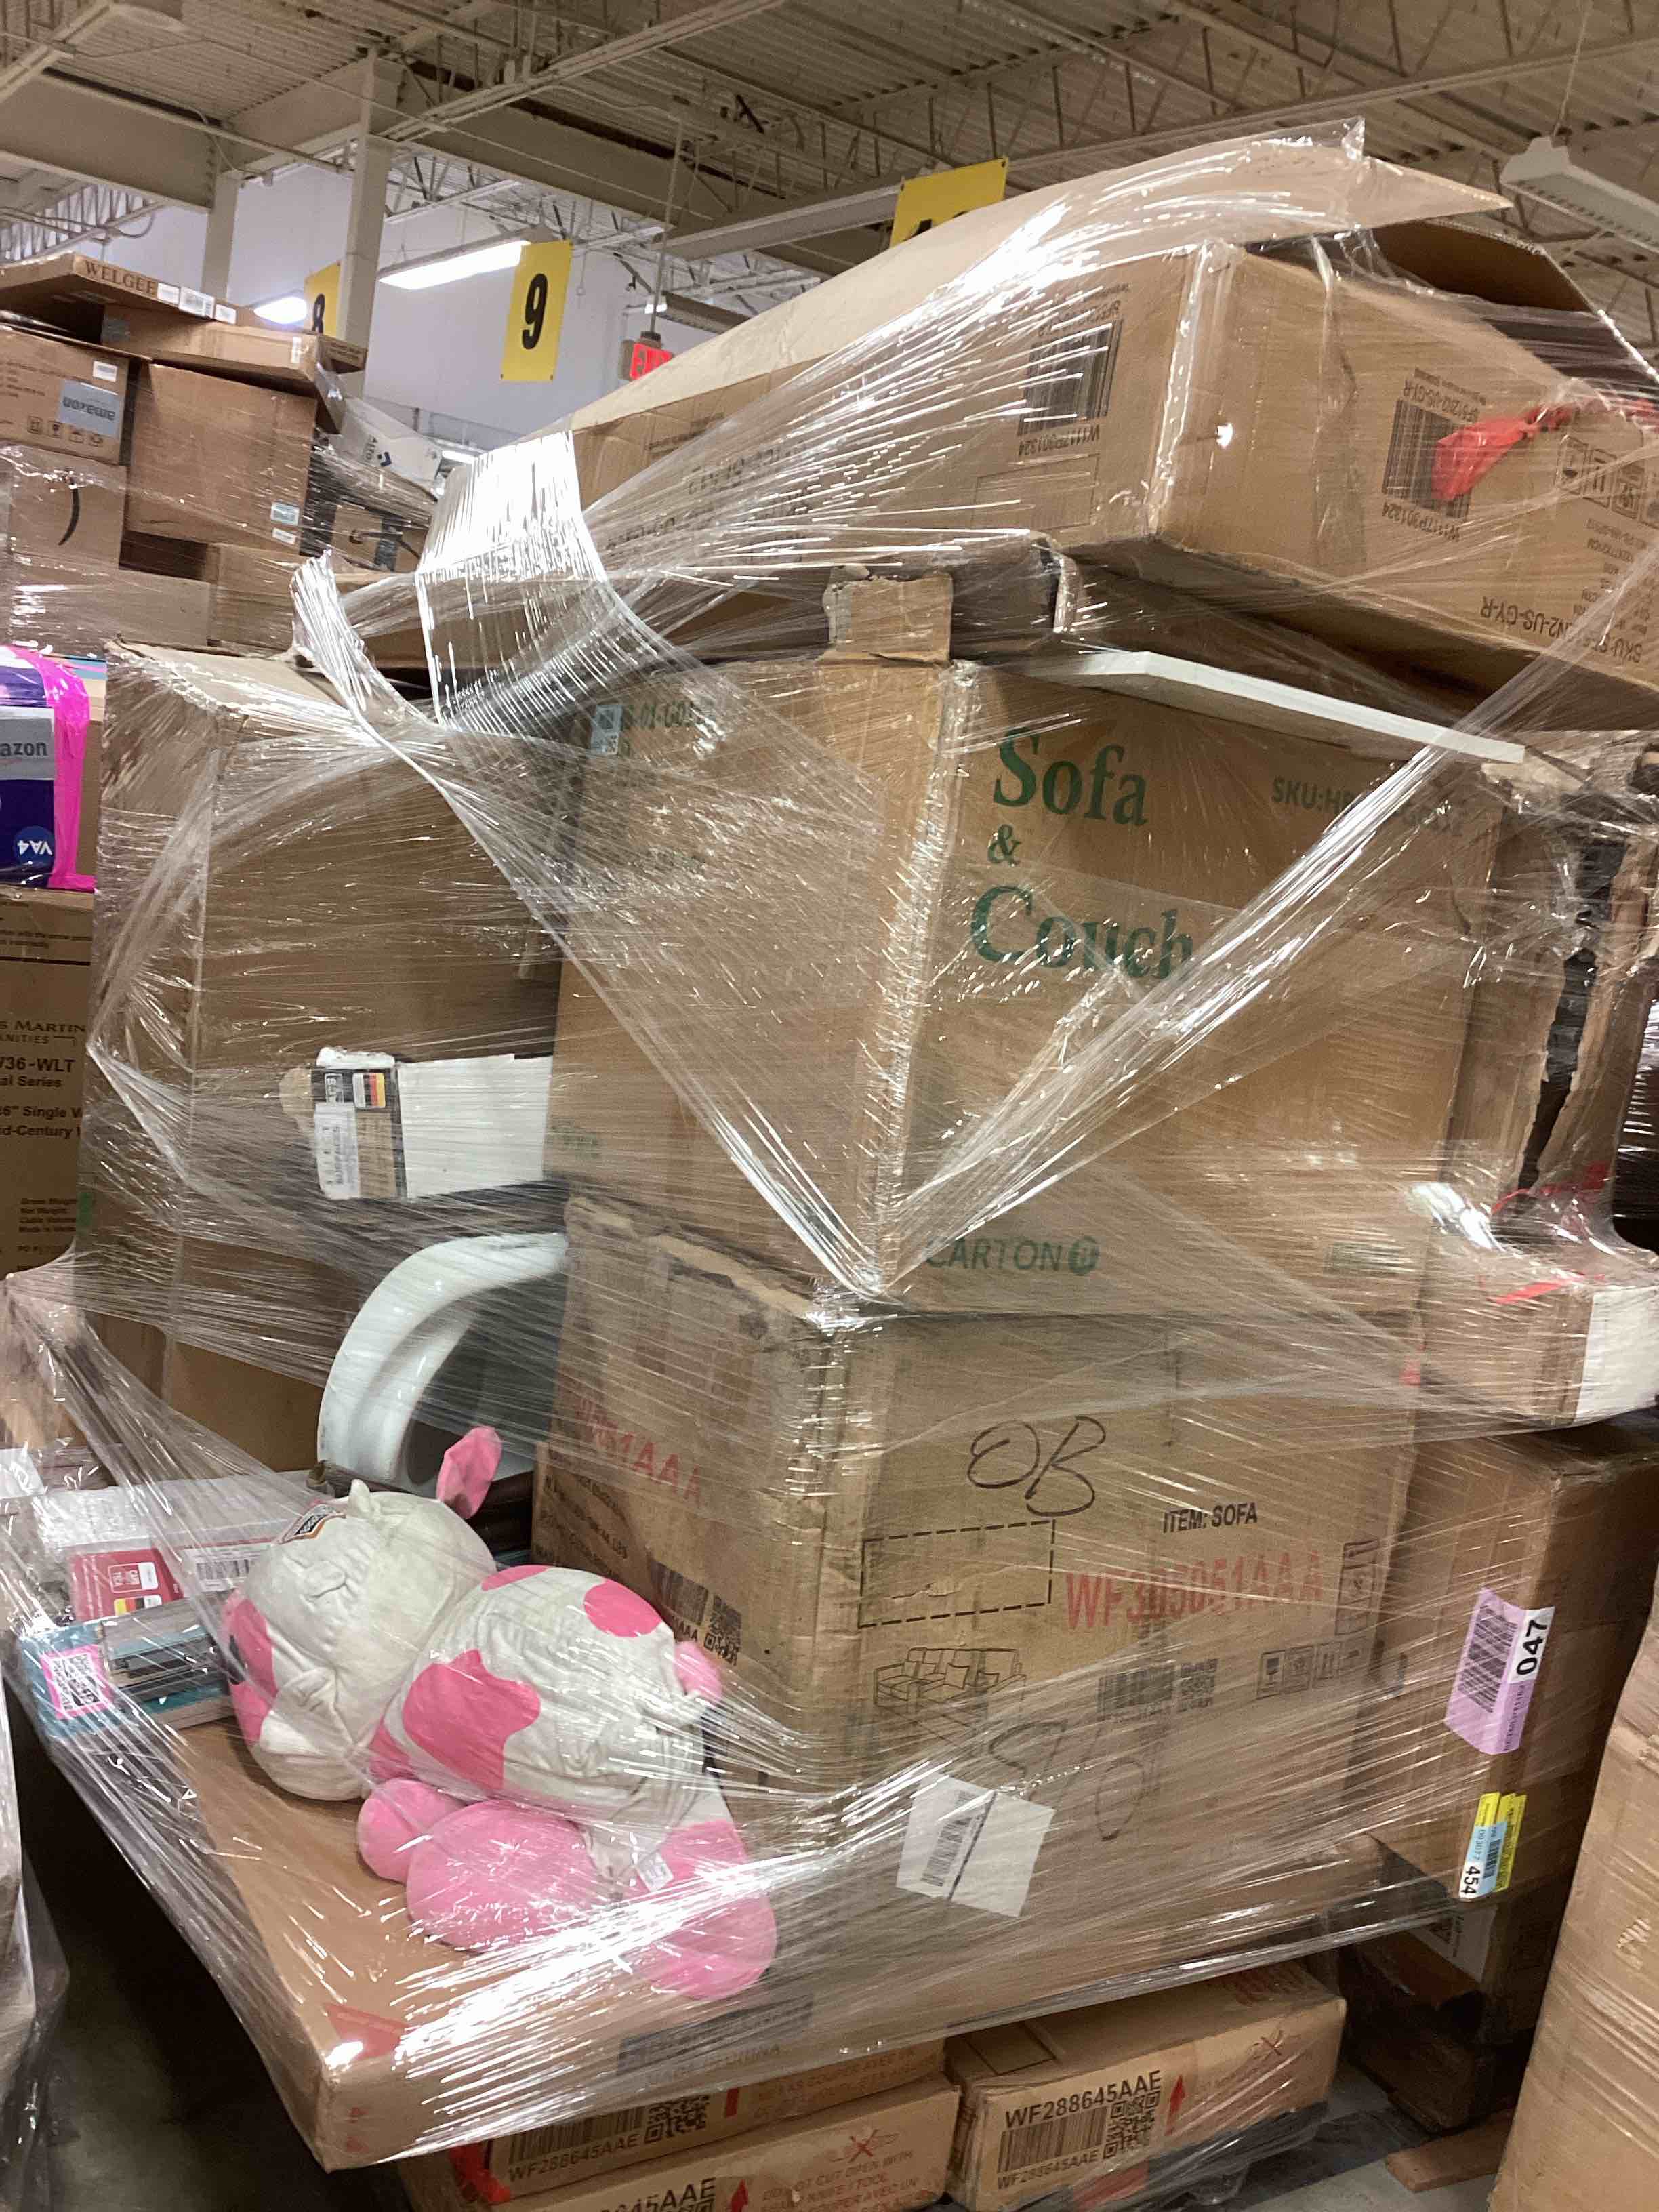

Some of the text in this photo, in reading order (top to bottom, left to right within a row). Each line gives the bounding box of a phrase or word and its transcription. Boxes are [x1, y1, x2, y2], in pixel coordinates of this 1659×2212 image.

[521, 272, 548, 350] 9
[992, 725, 1149, 827] Sofa
[987, 824, 1021, 865] &
[970, 885, 1193, 979] Couch
[15, 1020, 86, 1032] MARTIN
[18, 1076, 62, 1088] Series
[22, 1105, 67, 1120] Single
[924, 1235, 1063, 1273] CARTON
[1163, 1502, 1258, 1533] ITEM: SOFA
[1516, 1619, 1548, 1676] 047
[1460, 1864, 1481, 1896] 454
[1005, 2070, 1162, 2128] WF288645AAE
[600, 2177, 716, 2212] 645AAE
